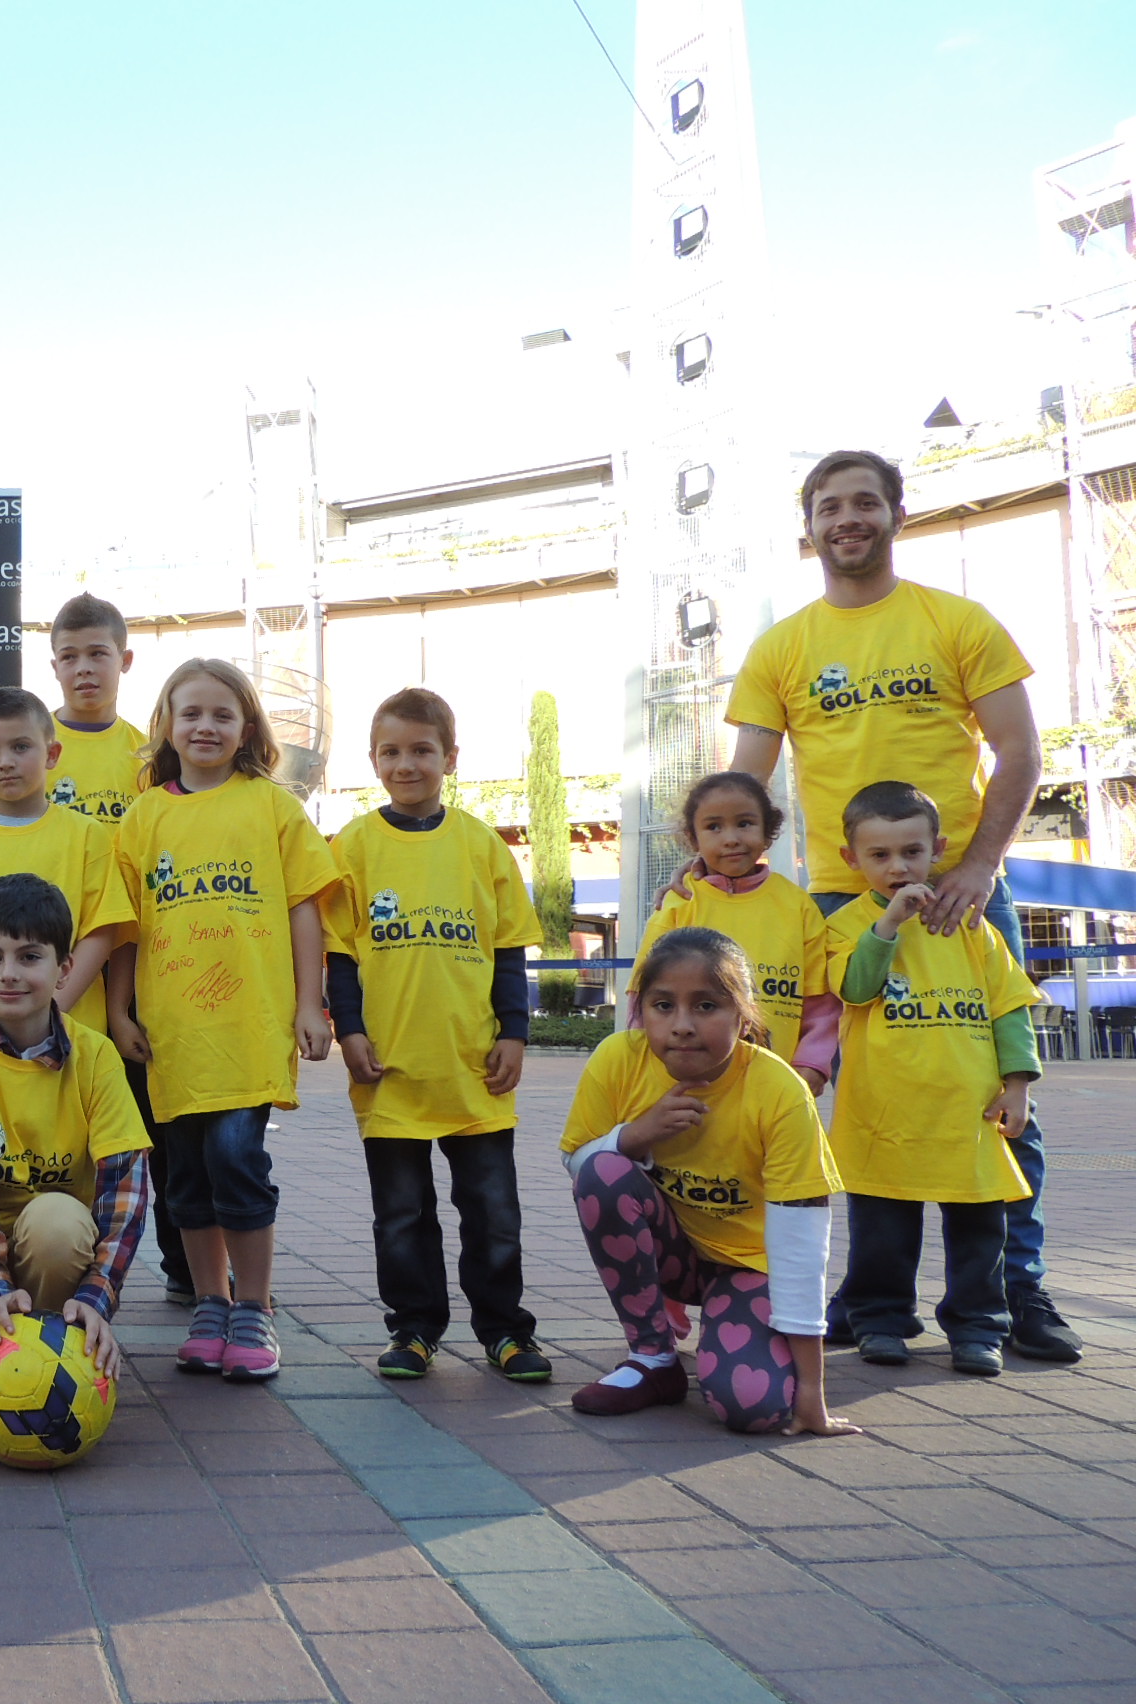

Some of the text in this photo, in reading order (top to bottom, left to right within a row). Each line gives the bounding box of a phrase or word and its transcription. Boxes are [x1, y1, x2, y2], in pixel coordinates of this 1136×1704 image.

[858, 663, 932, 684] creciendo
[820, 688, 868, 712] GOL
[870, 683, 886, 699] A
[888, 678, 938, 696] GOL
[96, 801, 109, 816] A
[182, 859, 252, 876] creciendo
[193, 877, 209, 894] A
[212, 875, 259, 895] GOL
[371, 921, 417, 942] GOL
[421, 920, 437, 938] A
[762, 978, 803, 999] GOL
[921, 986, 984, 1000] creciendo
[884, 1001, 988, 1021] GOL A GOL
[668, 1178, 748, 1205] A GOL
